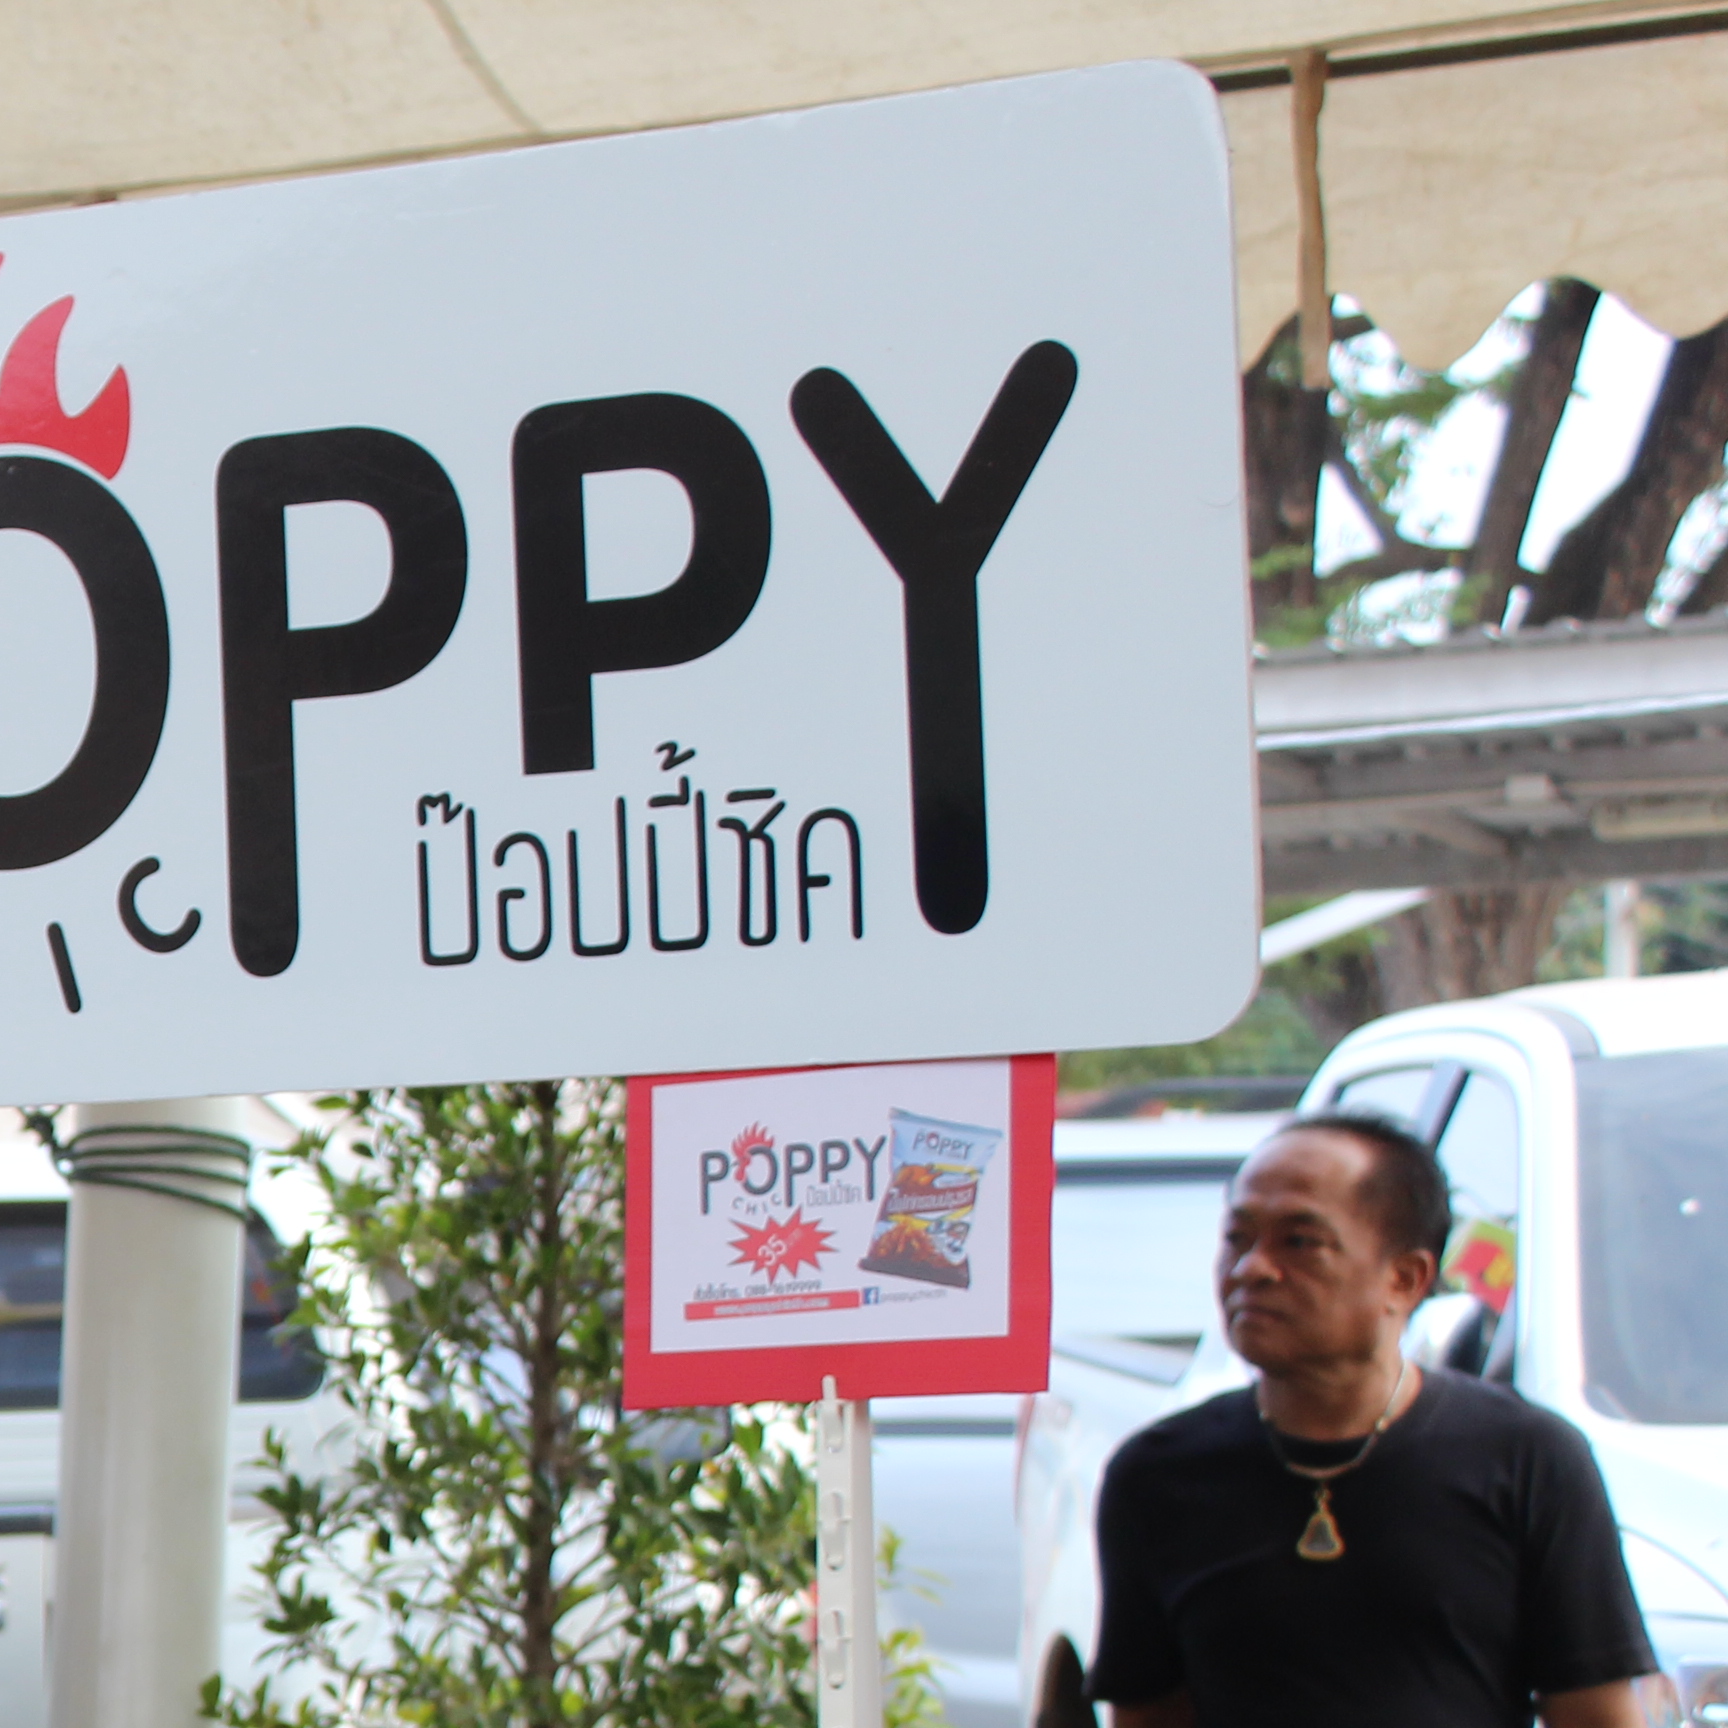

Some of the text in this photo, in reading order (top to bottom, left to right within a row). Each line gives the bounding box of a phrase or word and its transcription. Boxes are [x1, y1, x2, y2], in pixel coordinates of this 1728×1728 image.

[415, 742, 867, 970] ป๊อปปี้ชิค
[911, 1129, 974, 1161] POPPY
[700, 1135, 887, 1216] POPPY
[757, 1233, 788, 1267] 35
